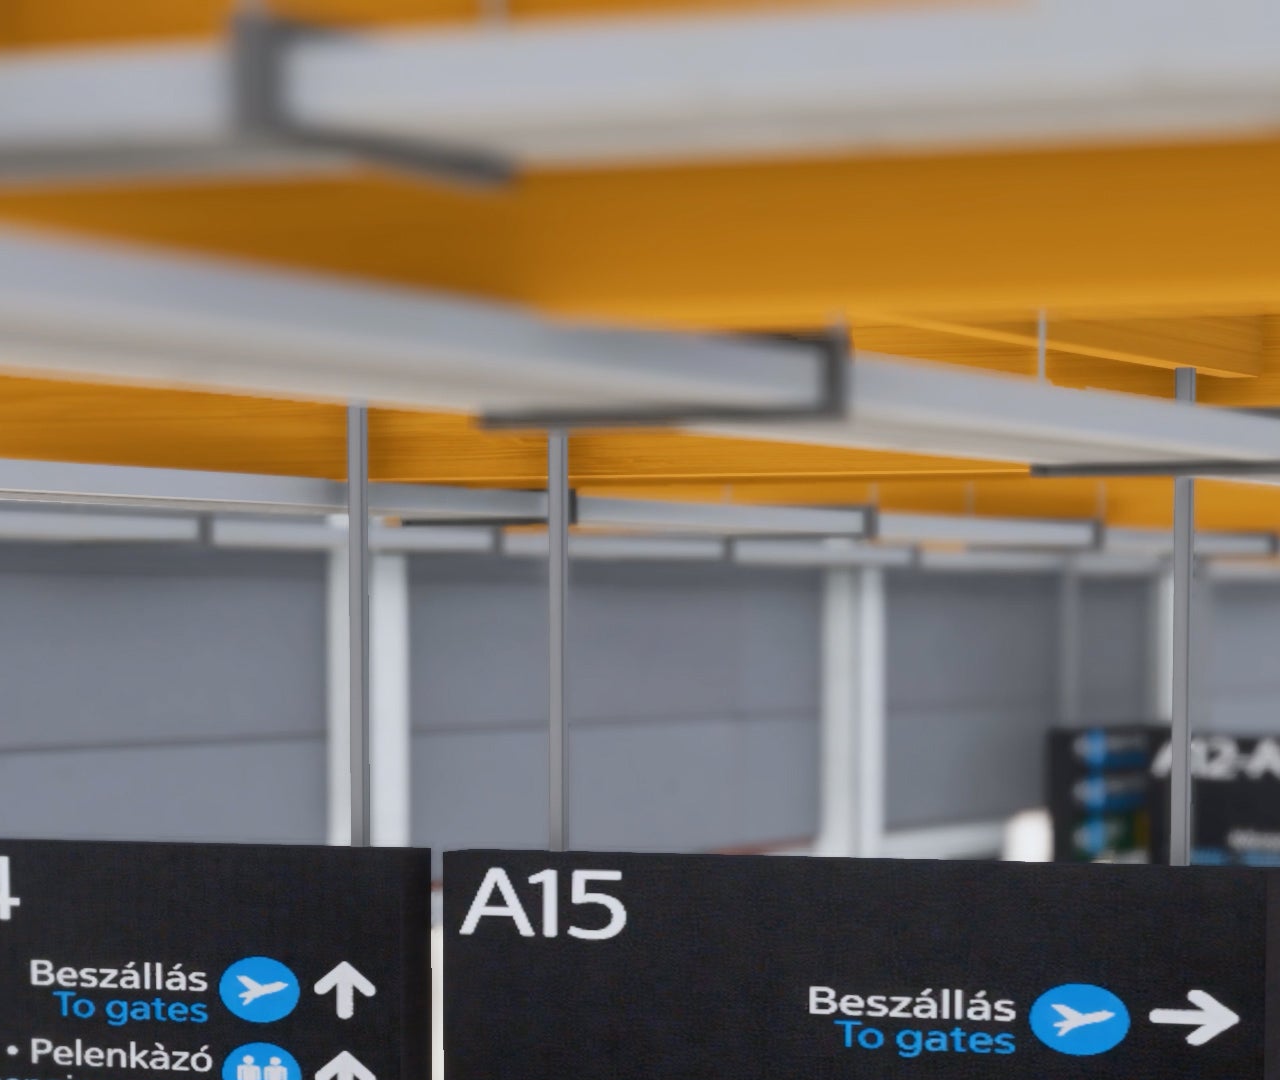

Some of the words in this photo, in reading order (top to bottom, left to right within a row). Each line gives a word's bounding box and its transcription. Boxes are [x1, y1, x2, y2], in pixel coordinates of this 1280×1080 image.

[458, 866, 628, 941] A15
[29, 958, 209, 993] Beszállás
[52, 990, 96, 1019] To
[104, 992, 209, 1027] gates
[808, 985, 1017, 1024] Beszállás
[833, 1019, 885, 1051] To
[895, 1022, 1016, 1058] gates
